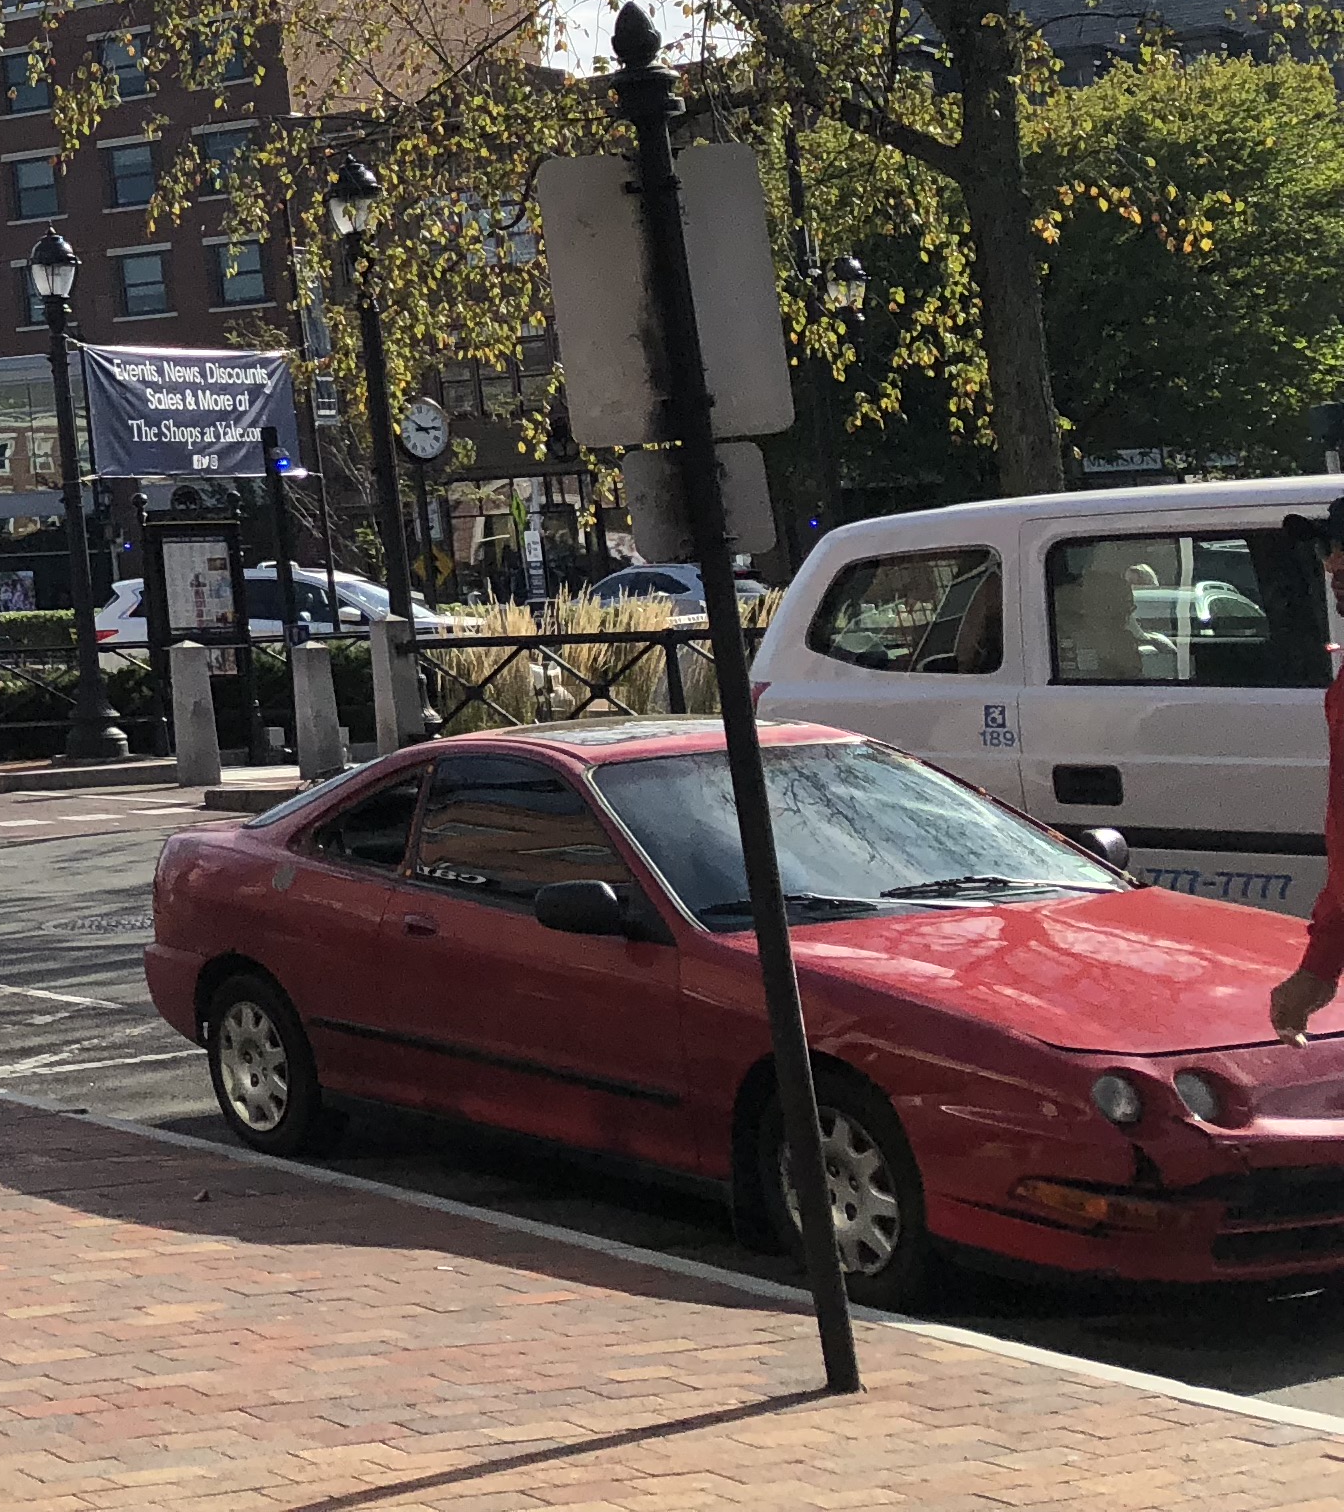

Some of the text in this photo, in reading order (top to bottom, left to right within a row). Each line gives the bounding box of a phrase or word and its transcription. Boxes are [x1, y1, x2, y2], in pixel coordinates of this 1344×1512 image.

[113, 359, 271, 385] Events, News, Discounts,
[146, 389, 250, 411] Sales & More at
[129, 419, 159, 442] The
[161, 419, 201, 449] Shops
[203, 424, 216, 442] at
[980, 730, 1015, 747] 189
[1145, 868, 1292, 900] 777-7777
